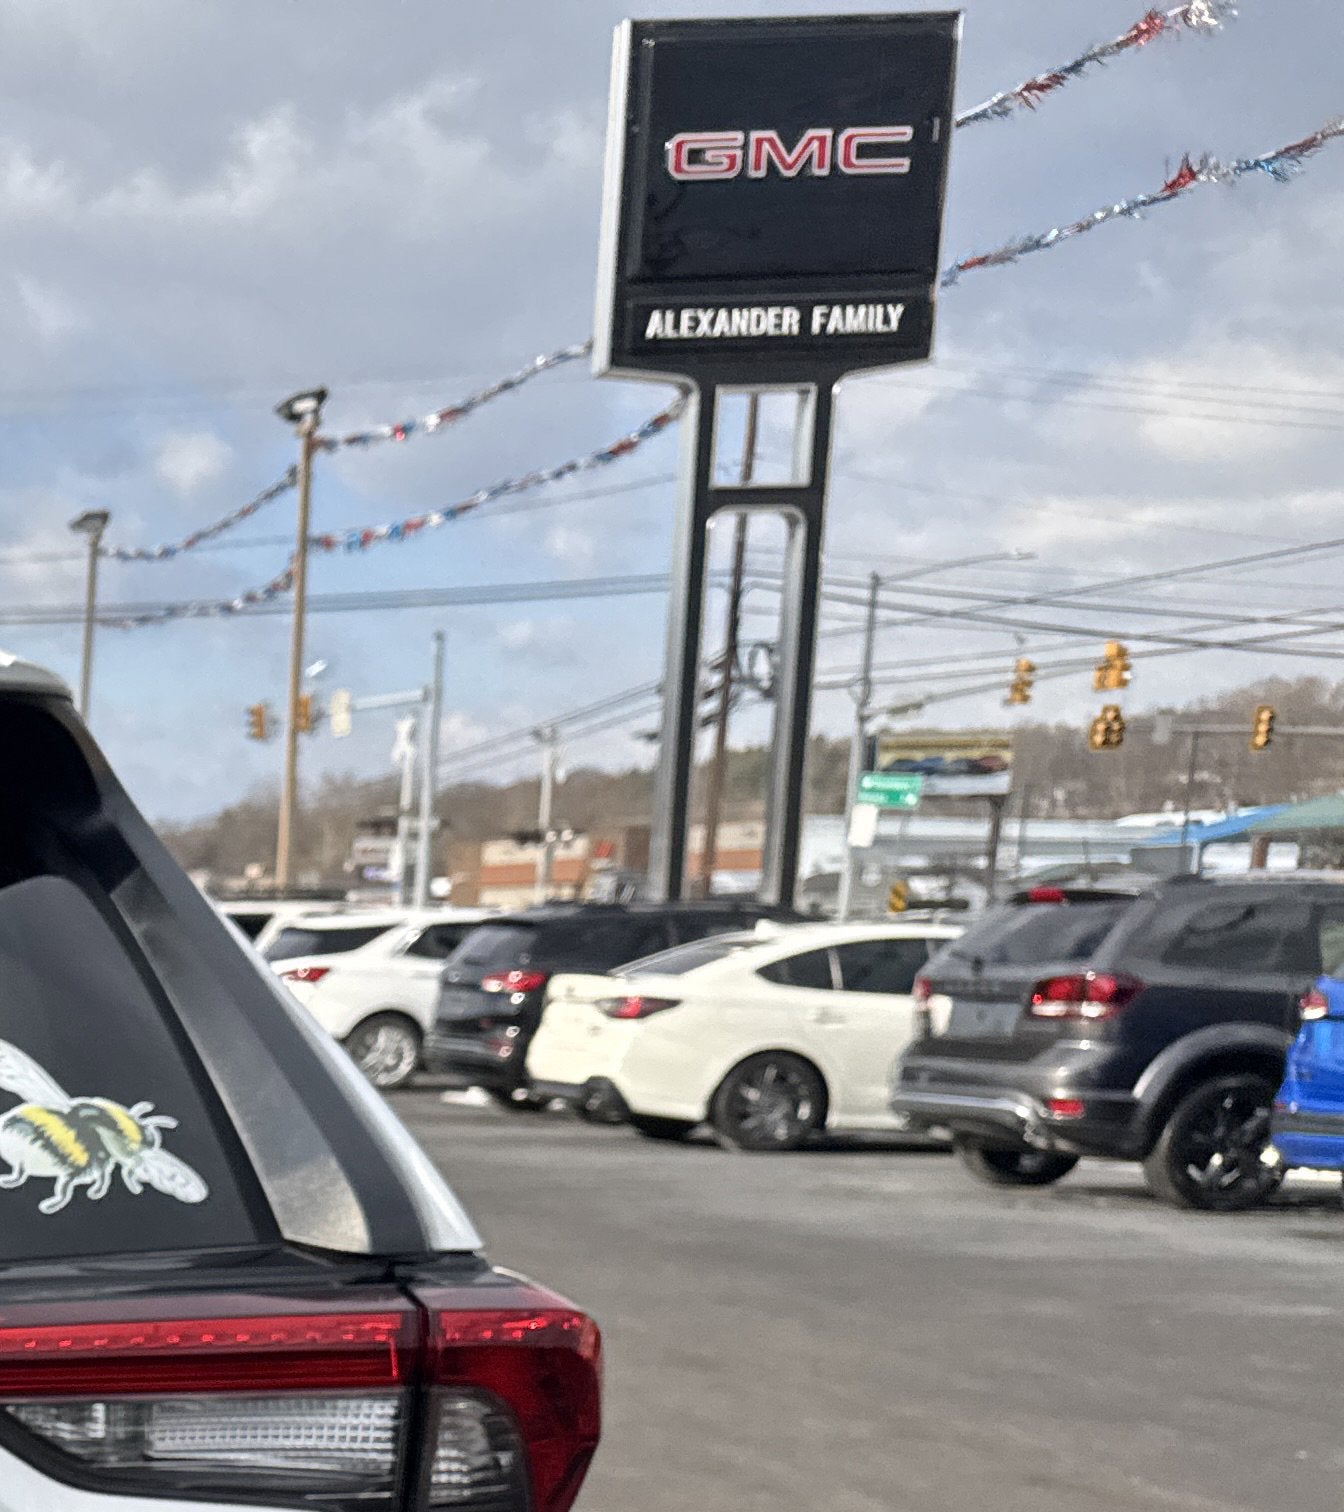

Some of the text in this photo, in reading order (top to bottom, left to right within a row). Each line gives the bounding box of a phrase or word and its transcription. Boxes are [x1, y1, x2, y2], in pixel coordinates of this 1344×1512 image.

[666, 126, 913, 180] GMC
[645, 303, 905, 340] ALEXANDER FAMILY
